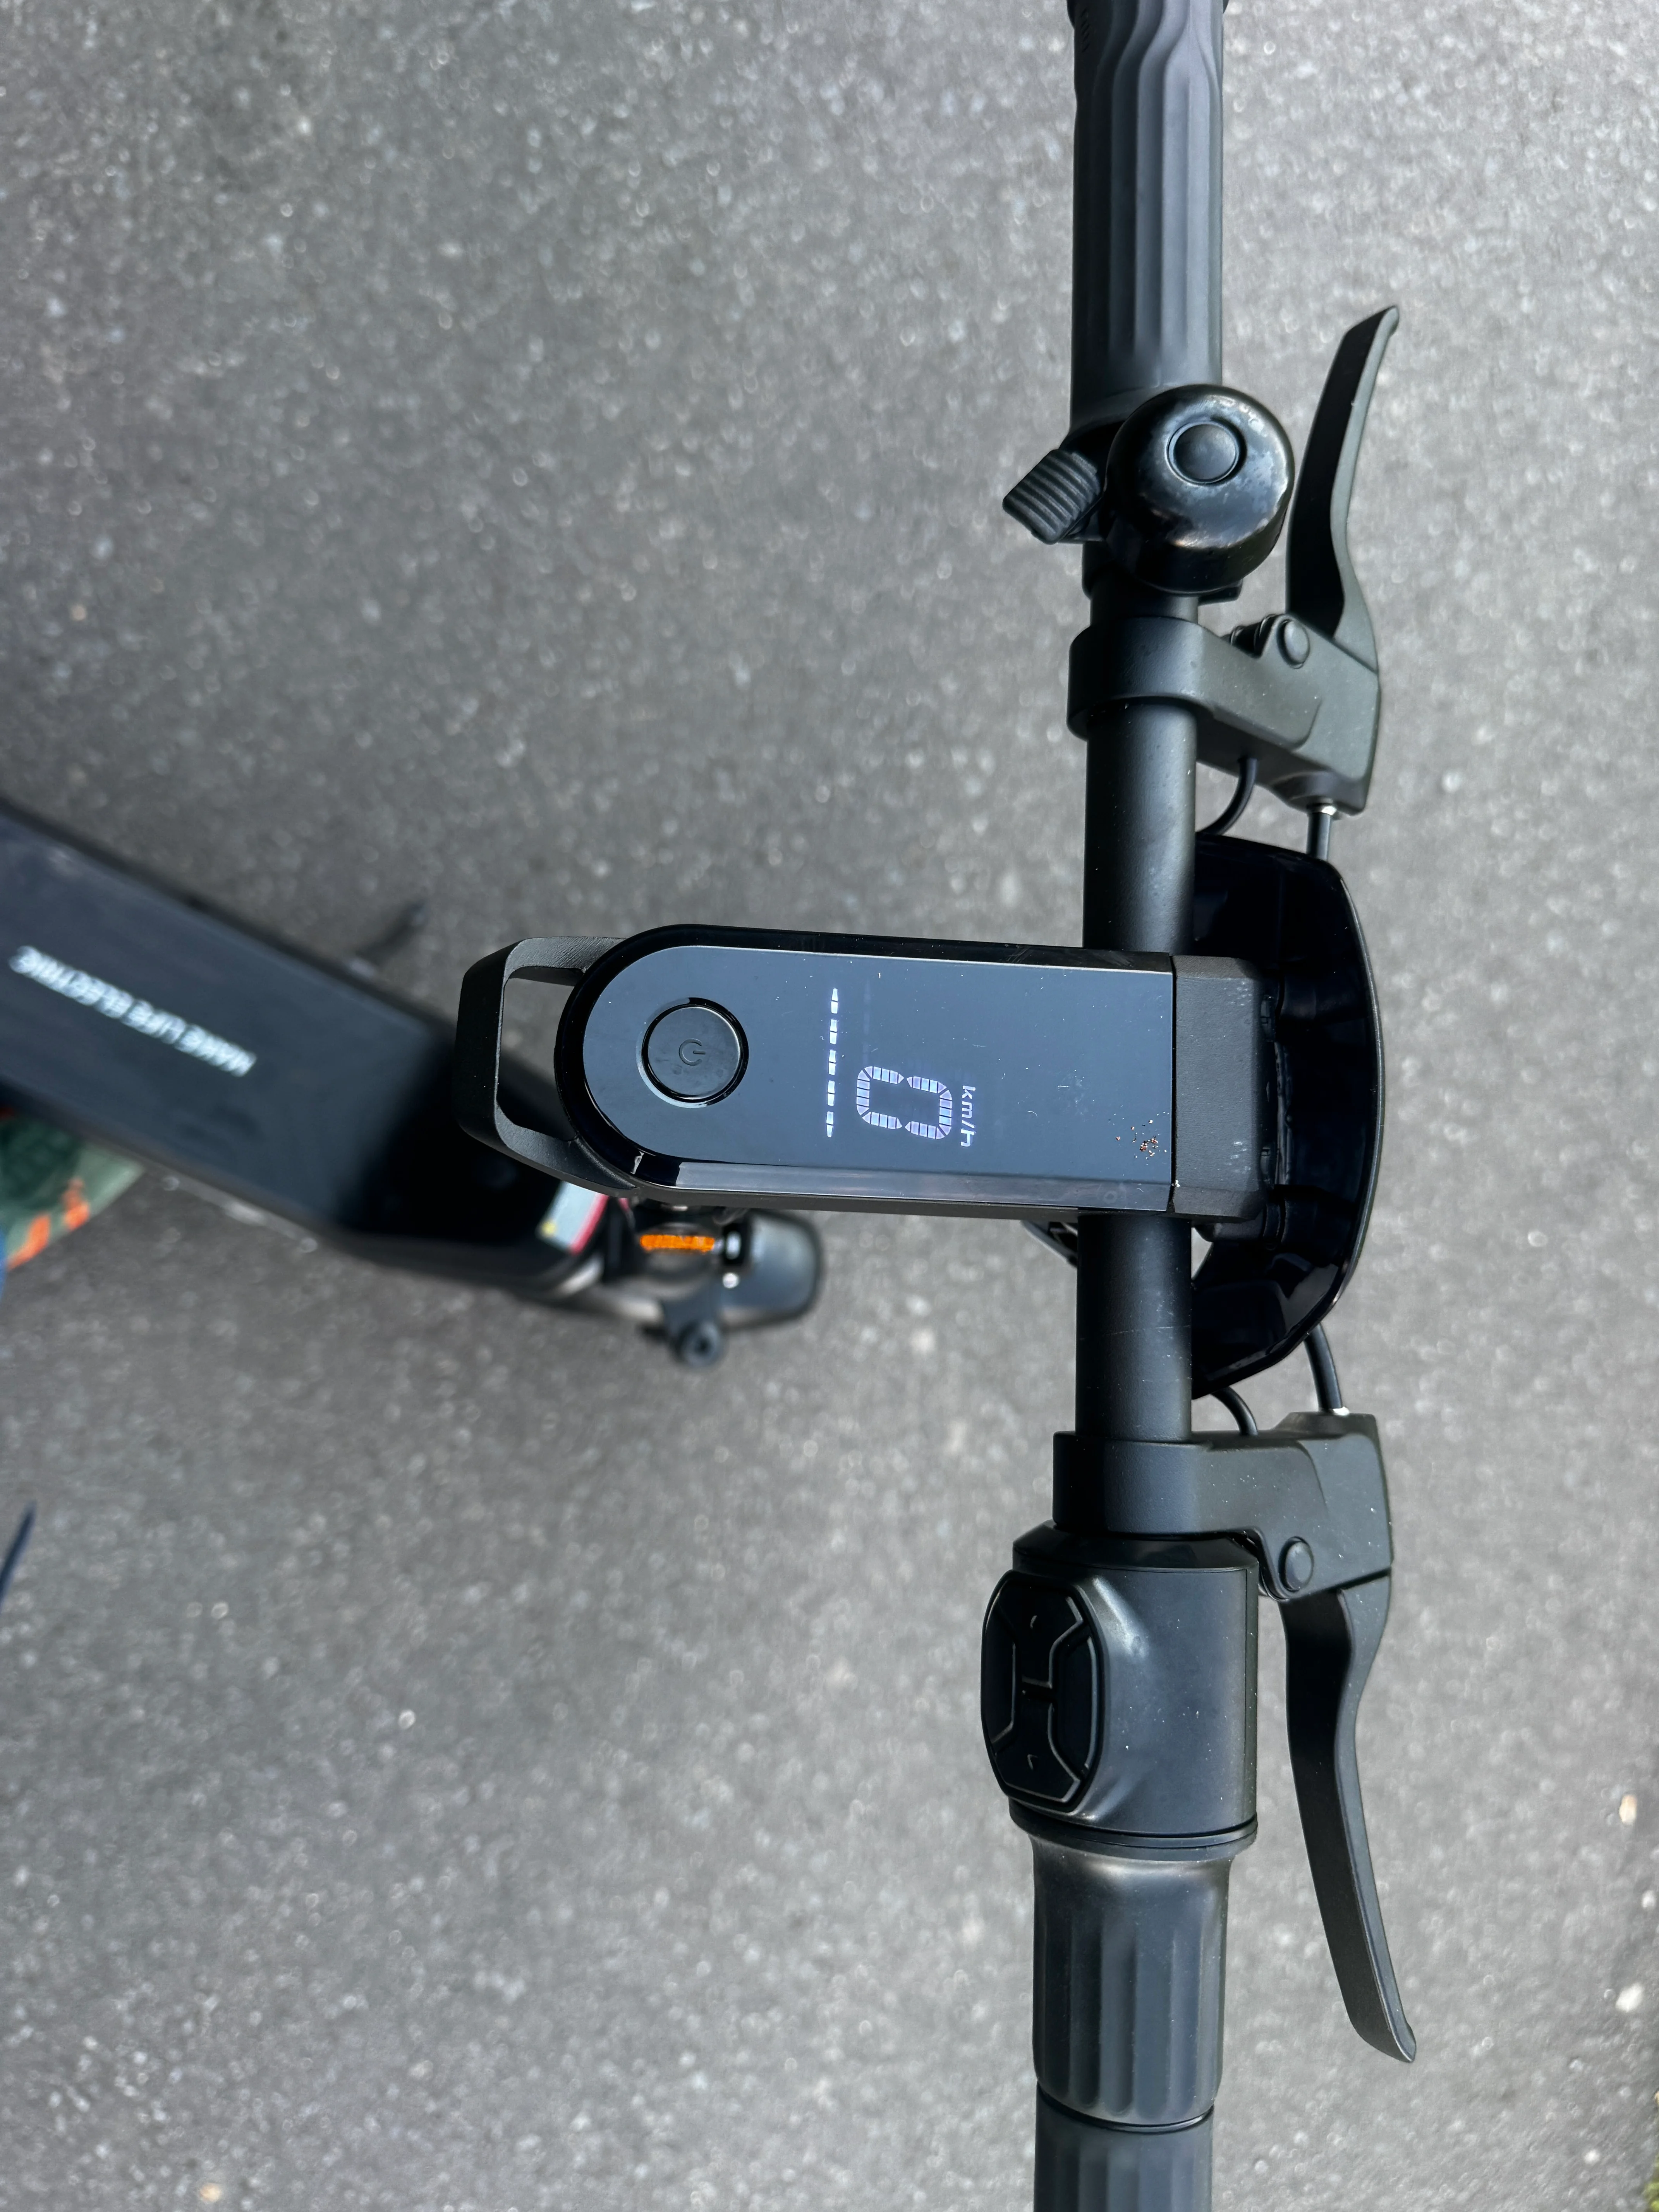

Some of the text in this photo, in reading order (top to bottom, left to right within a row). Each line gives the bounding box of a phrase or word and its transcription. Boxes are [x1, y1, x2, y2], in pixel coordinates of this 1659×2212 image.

[174, 1024, 256, 1077] MAKE
[856, 1066, 952, 1139] 0
[960, 1085, 976, 1147] km/h
